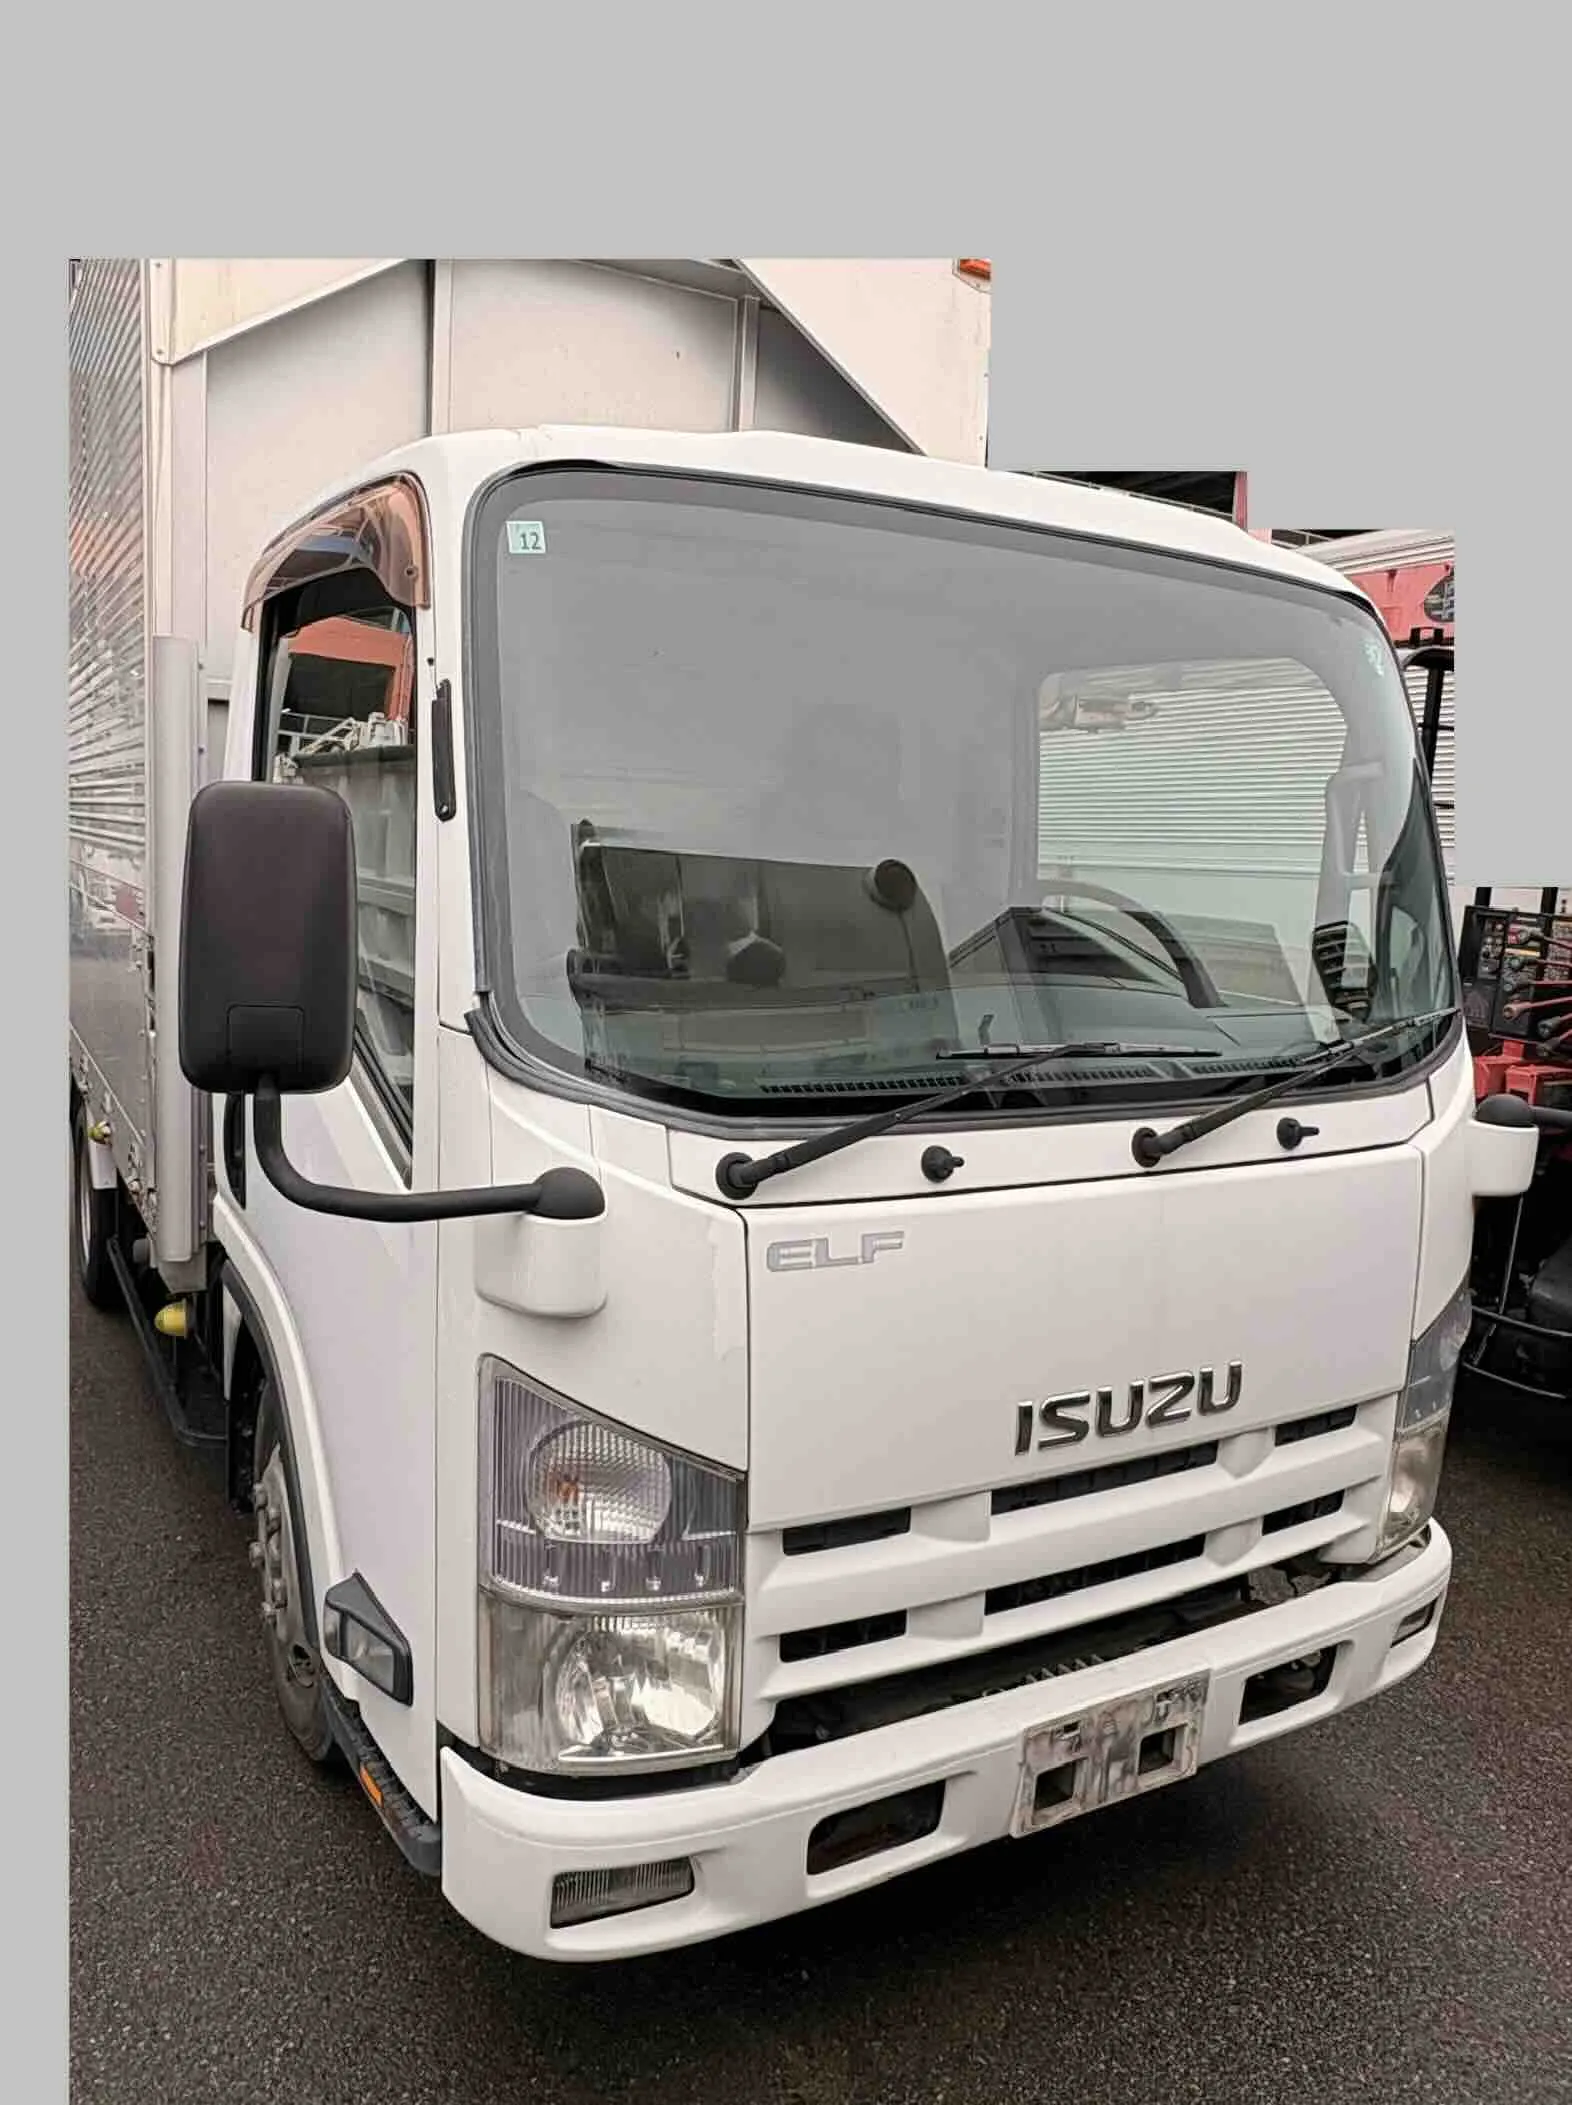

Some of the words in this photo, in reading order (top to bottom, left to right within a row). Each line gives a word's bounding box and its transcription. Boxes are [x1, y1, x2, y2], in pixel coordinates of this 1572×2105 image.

[520, 531, 542, 550] 12
[766, 1231, 905, 1272] ELF
[1014, 1360, 1243, 1456] ISUZU
